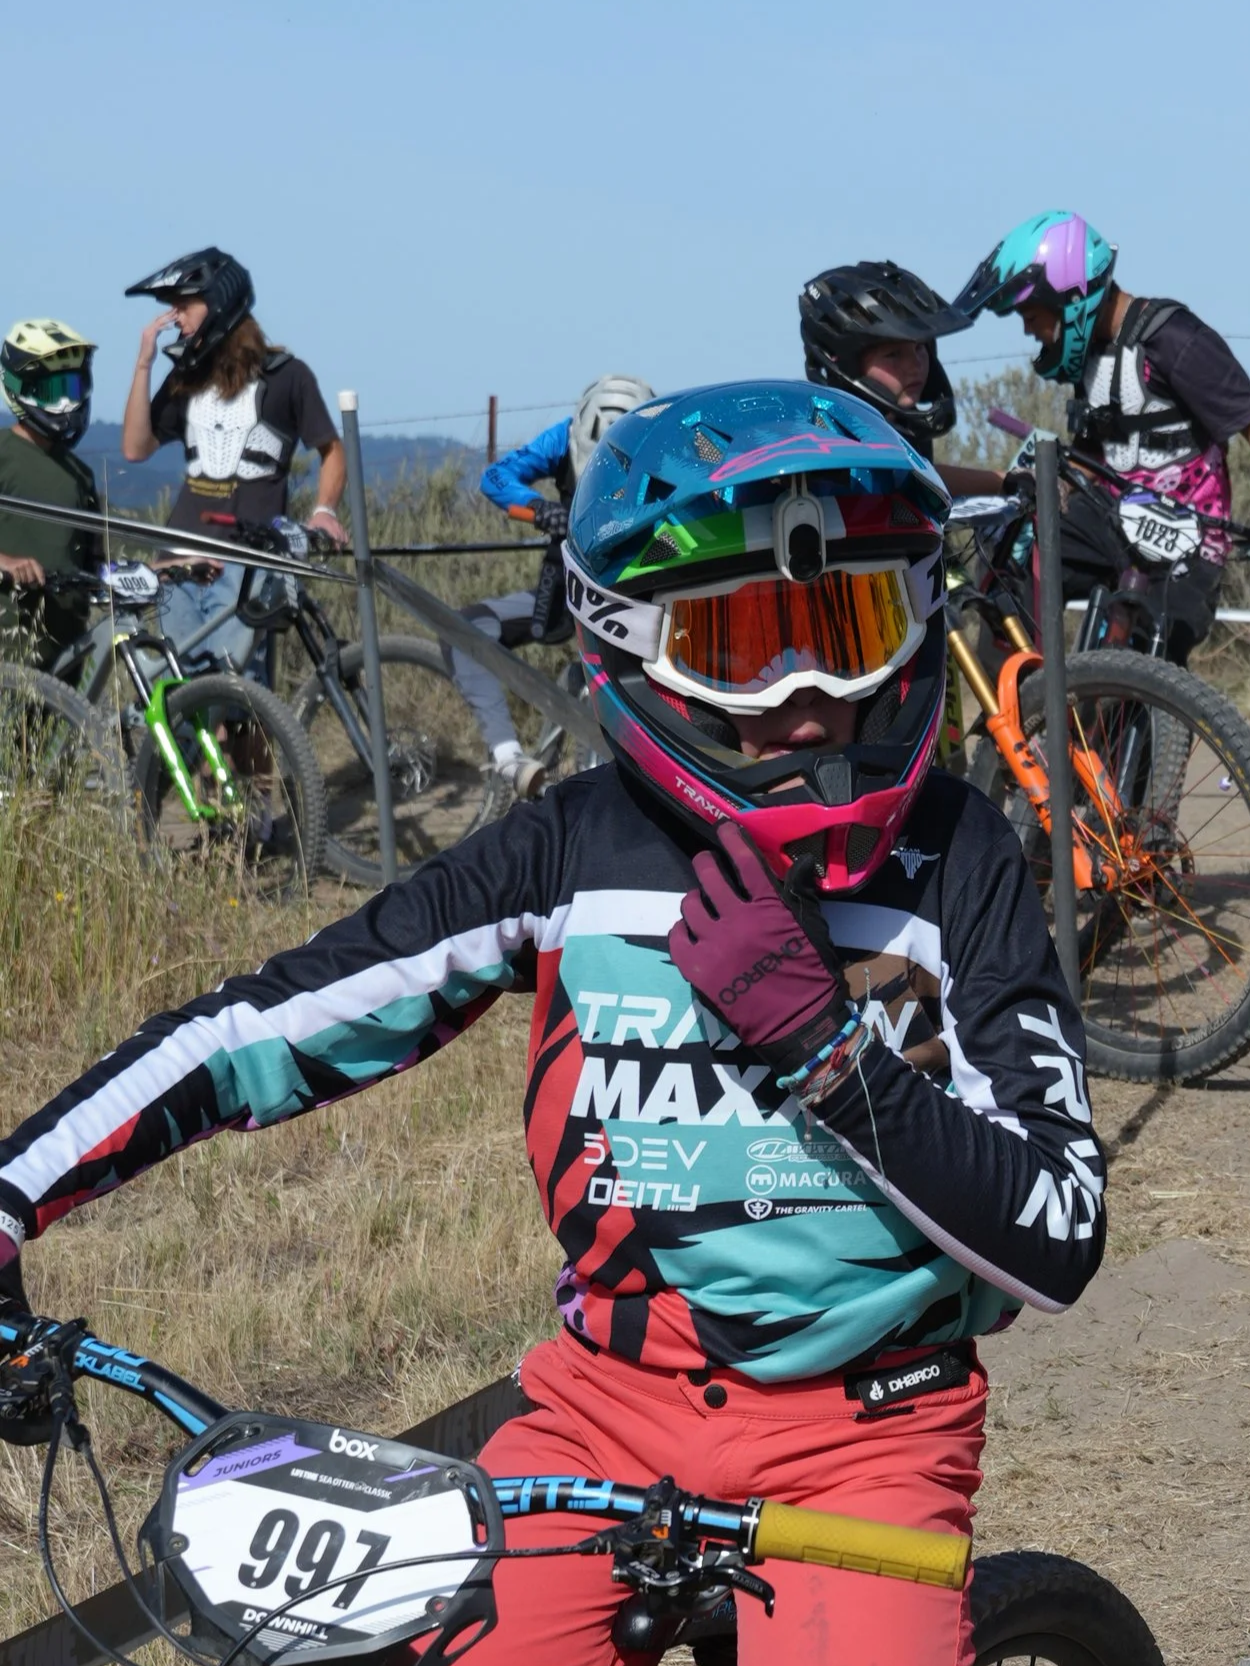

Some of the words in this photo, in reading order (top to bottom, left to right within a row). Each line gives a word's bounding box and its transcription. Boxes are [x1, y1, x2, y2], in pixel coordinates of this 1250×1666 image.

[1135, 515, 1179, 553] 1023
[779, 1170, 867, 1188] MAGURA
[588, 1178, 700, 1213] DEITY
[775, 1206, 793, 1215] THE
[794, 1204, 834, 1214] GRAVITY
[834, 1203, 868, 1213] CARTEL
[329, 1428, 379, 1462] box
[213, 1449, 282, 1478] JUNIORS
[318, 1474, 333, 1484] SEA
[333, 1477, 355, 1490] OTTER
[364, 1485, 392, 1499] CLASSIC
[493, 1475, 615, 1514] EITY
[238, 1507, 392, 1610] 997
[732, 1573, 764, 1593] MAGURA
